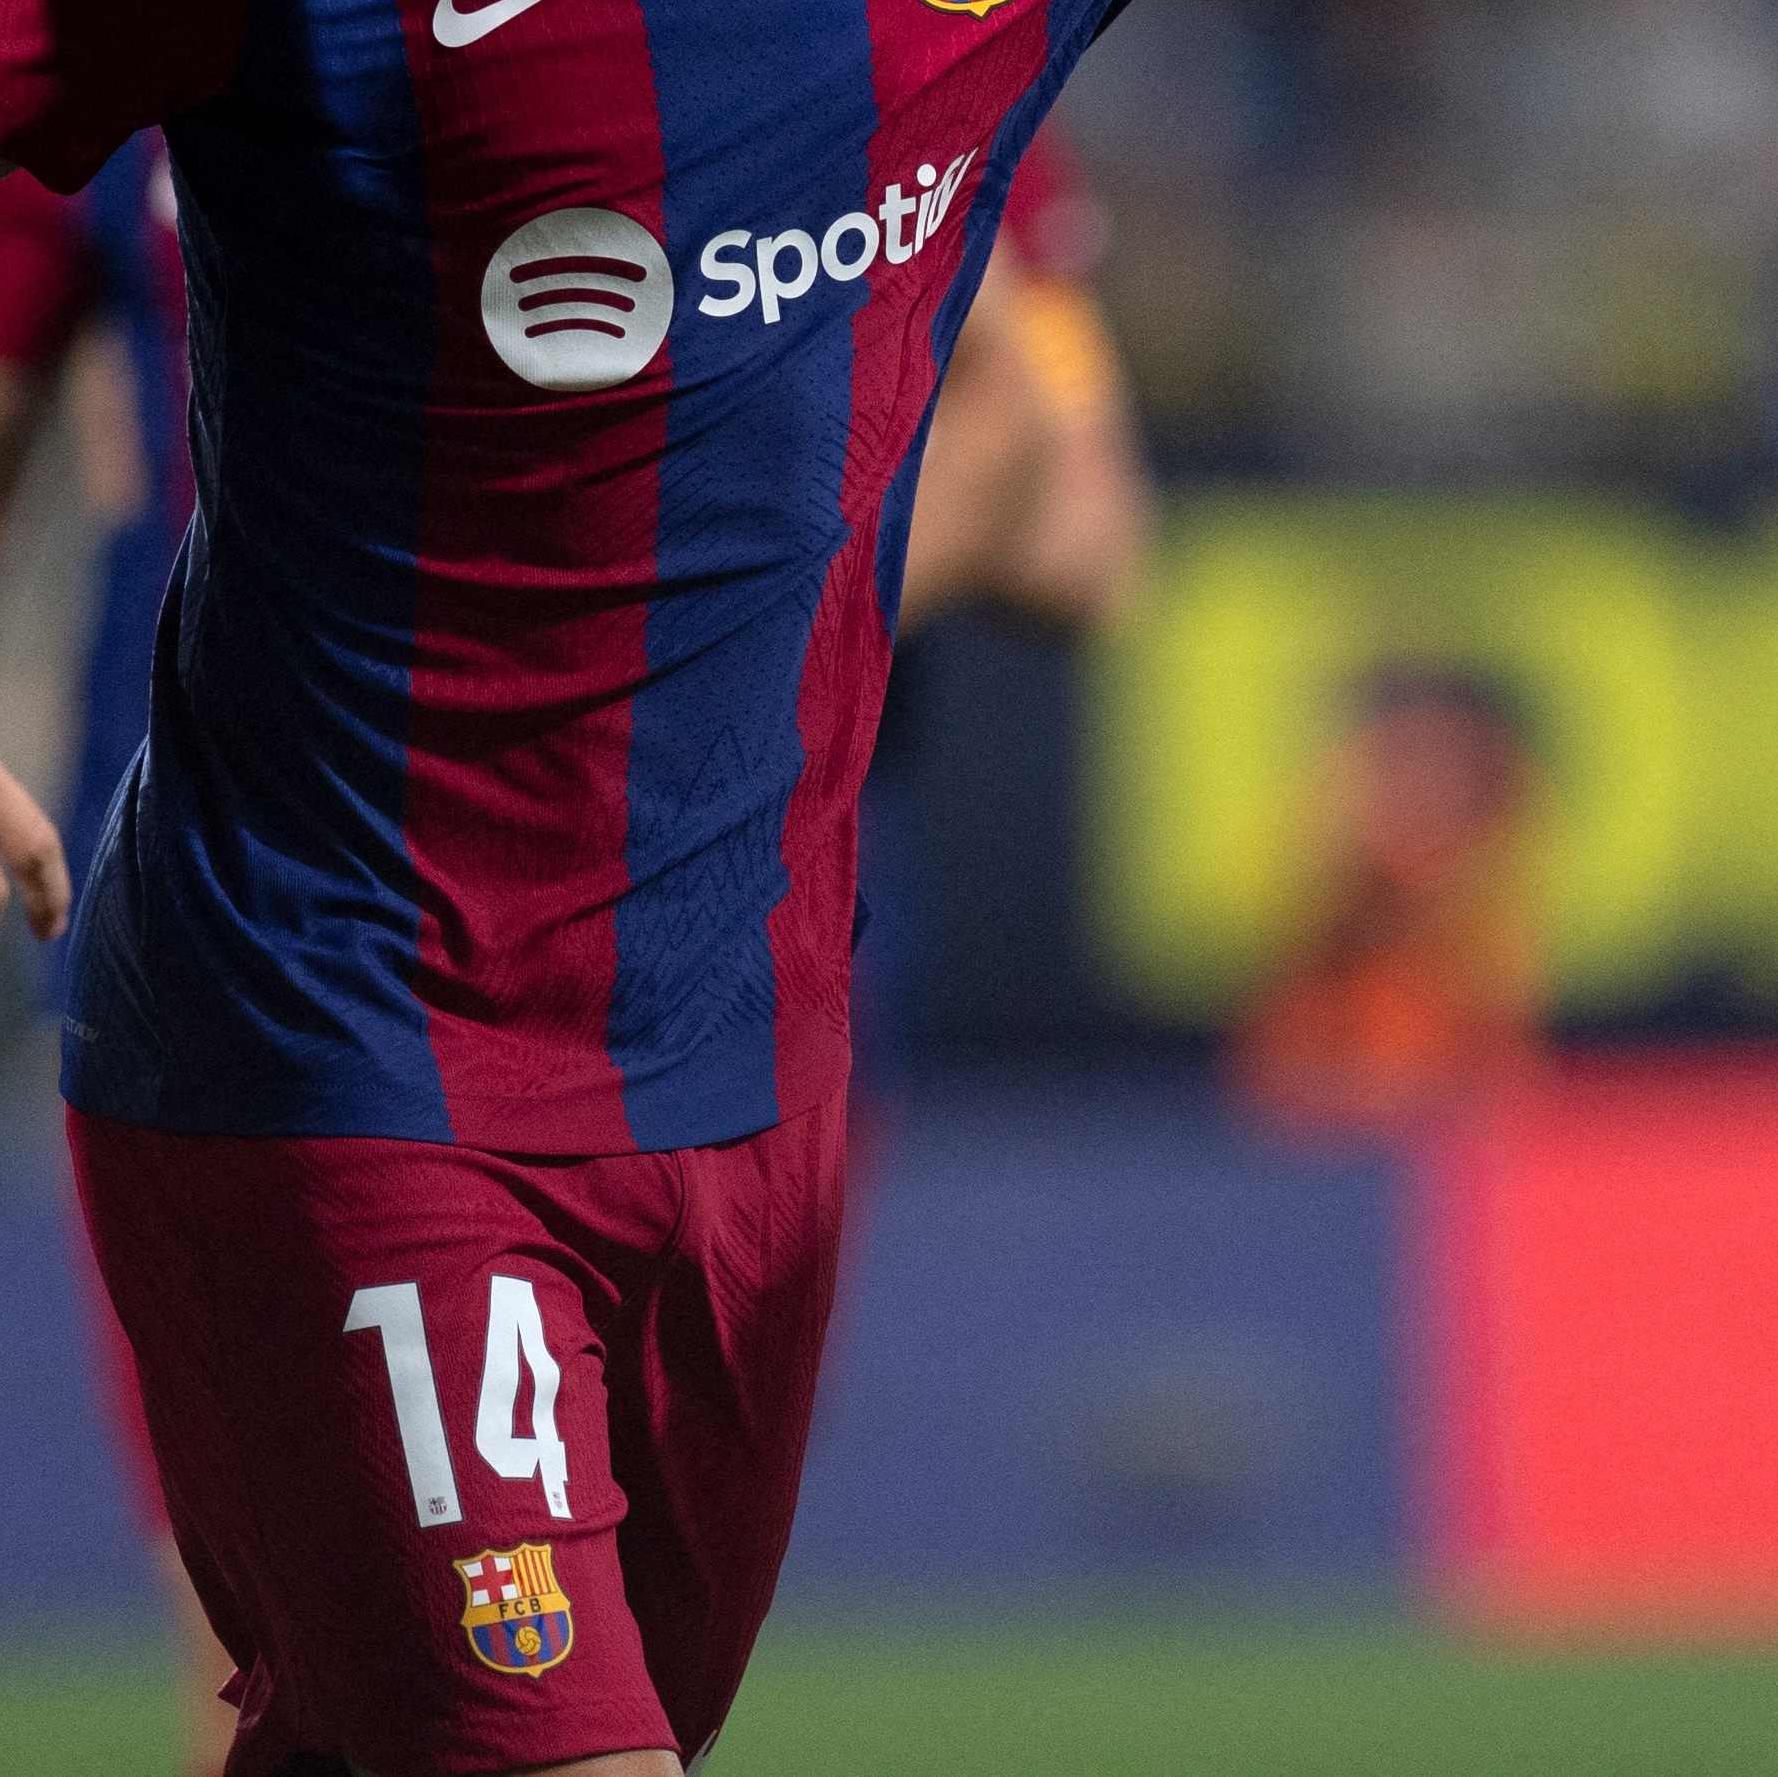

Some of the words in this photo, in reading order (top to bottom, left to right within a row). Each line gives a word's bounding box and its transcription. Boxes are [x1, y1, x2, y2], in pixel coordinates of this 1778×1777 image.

[698, 146, 980, 324] Spotify
[343, 1275, 572, 1527] 14
[498, 1598, 541, 1619] FCB
